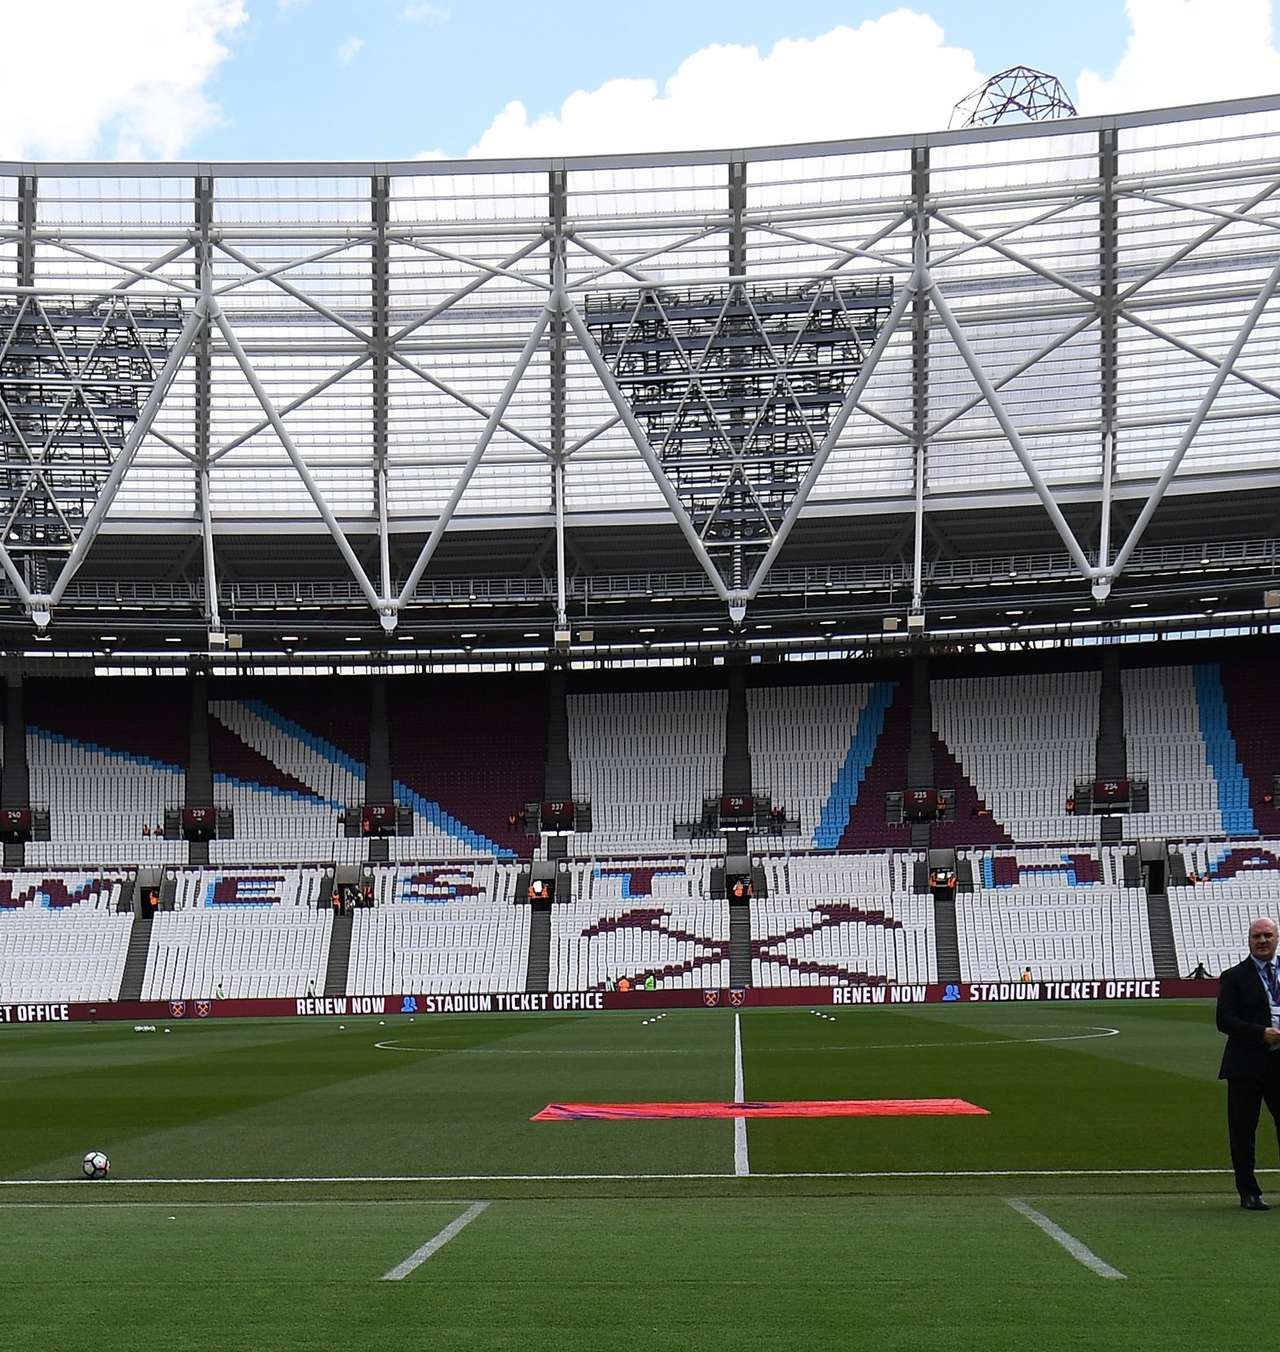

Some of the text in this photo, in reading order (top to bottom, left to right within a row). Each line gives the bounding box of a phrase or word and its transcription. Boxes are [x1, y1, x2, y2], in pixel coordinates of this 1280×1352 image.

[8, 811, 21, 819] 240
[833, 980, 1160, 1004] RENEW NOW STADIUM TICKET OFFICE
[17, 1004, 69, 1022] OFFICE
[296, 993, 603, 1015] RENEW NOW STADIUM TICKET OFFICE
